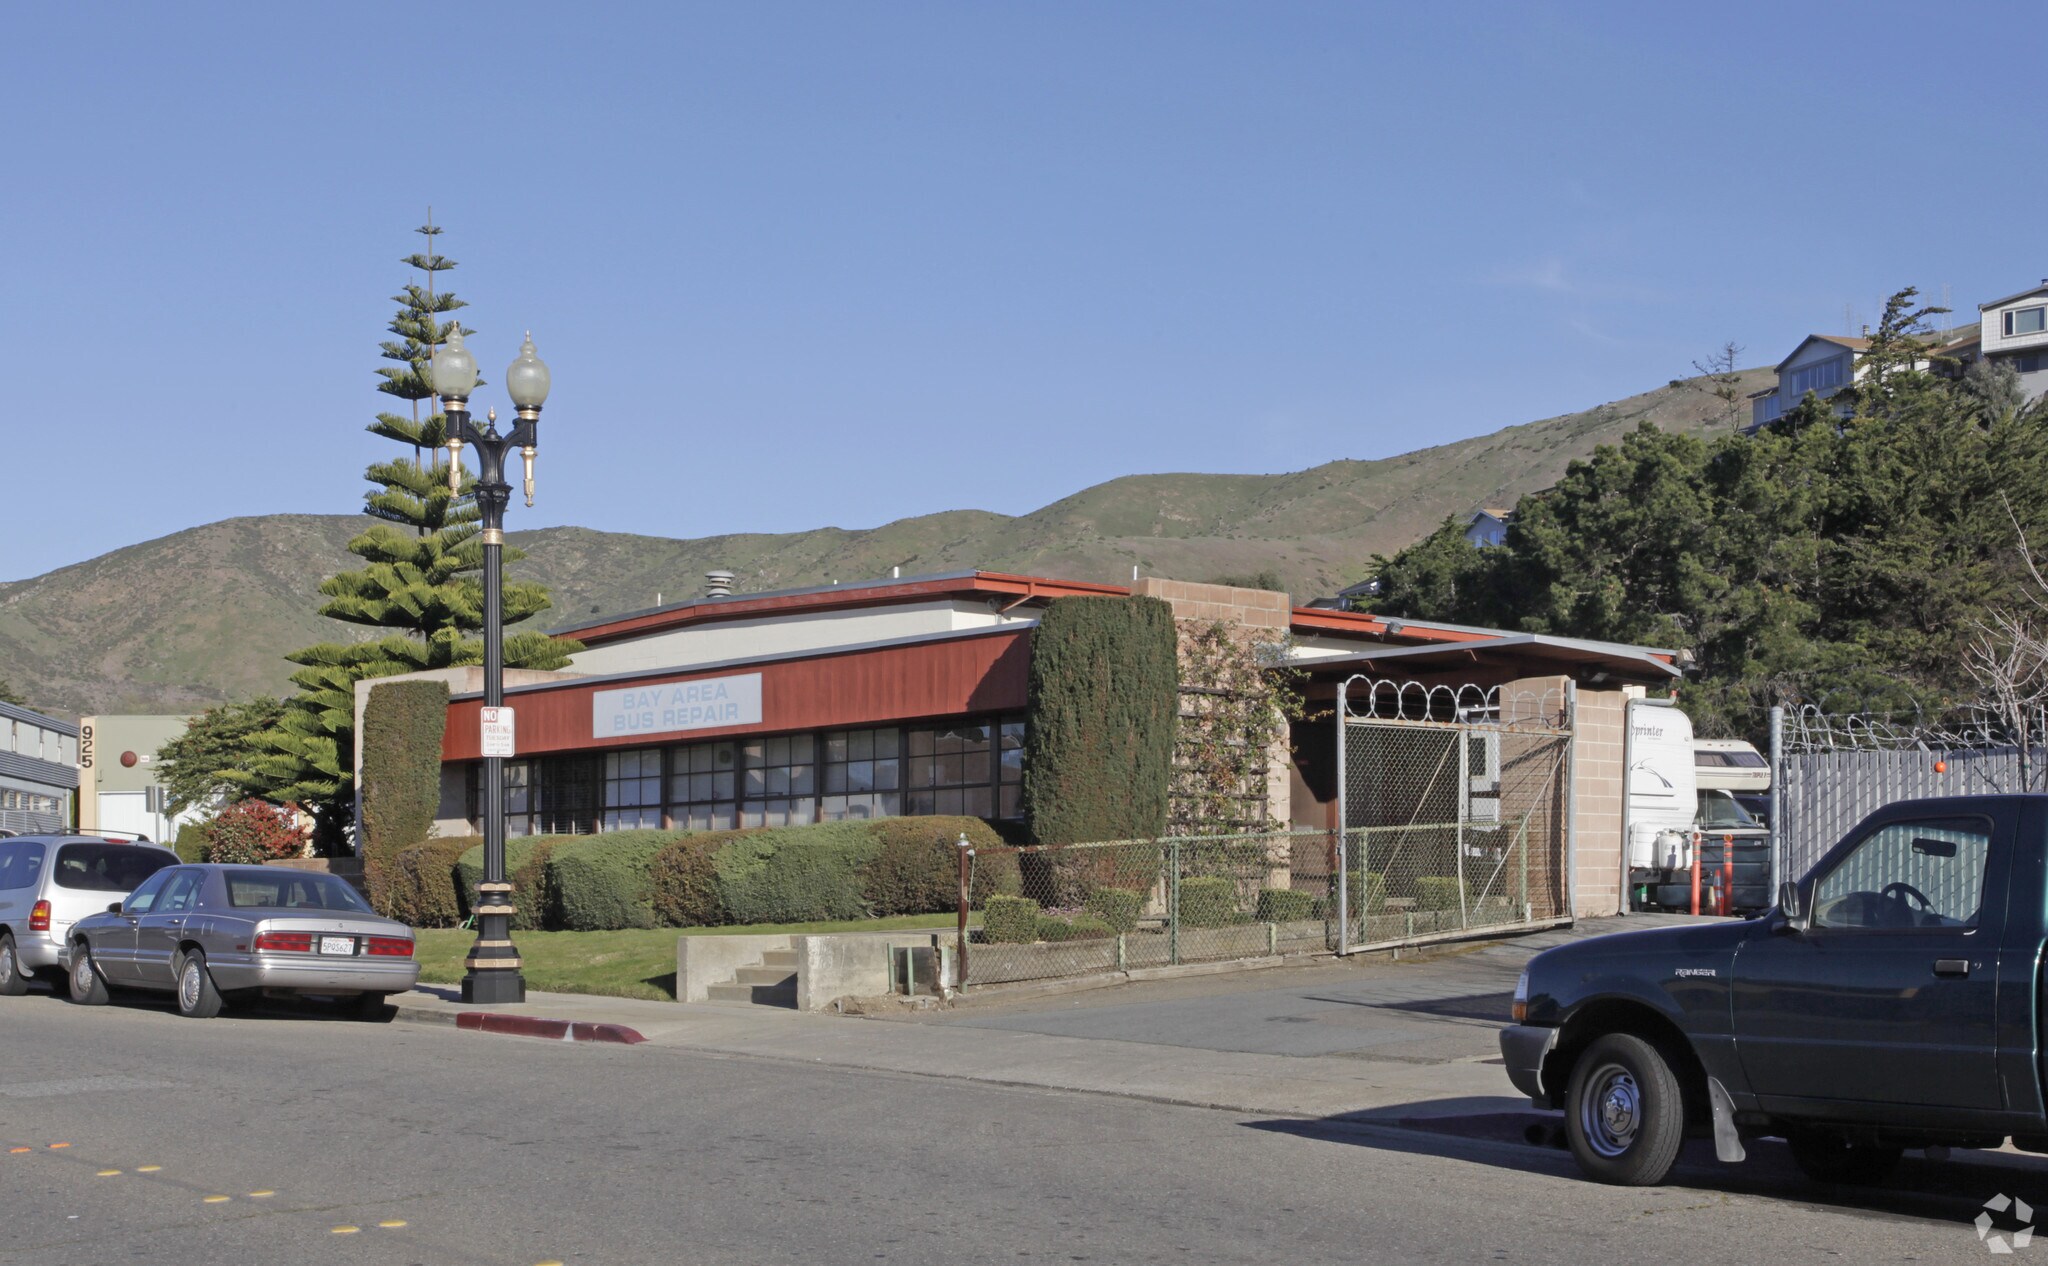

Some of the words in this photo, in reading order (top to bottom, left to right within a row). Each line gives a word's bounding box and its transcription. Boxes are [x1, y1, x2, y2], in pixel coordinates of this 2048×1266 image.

[623, 689, 663, 710] BAY
[672, 682, 728, 704] AREA
[484, 710, 496, 721] NO
[614, 711, 654, 731] BUS
[663, 703, 738, 726] REPAIR
[485, 725, 511, 734] PARKING
[82, 725, 93, 768] 925
[1675, 968, 1716, 978] RANGER
